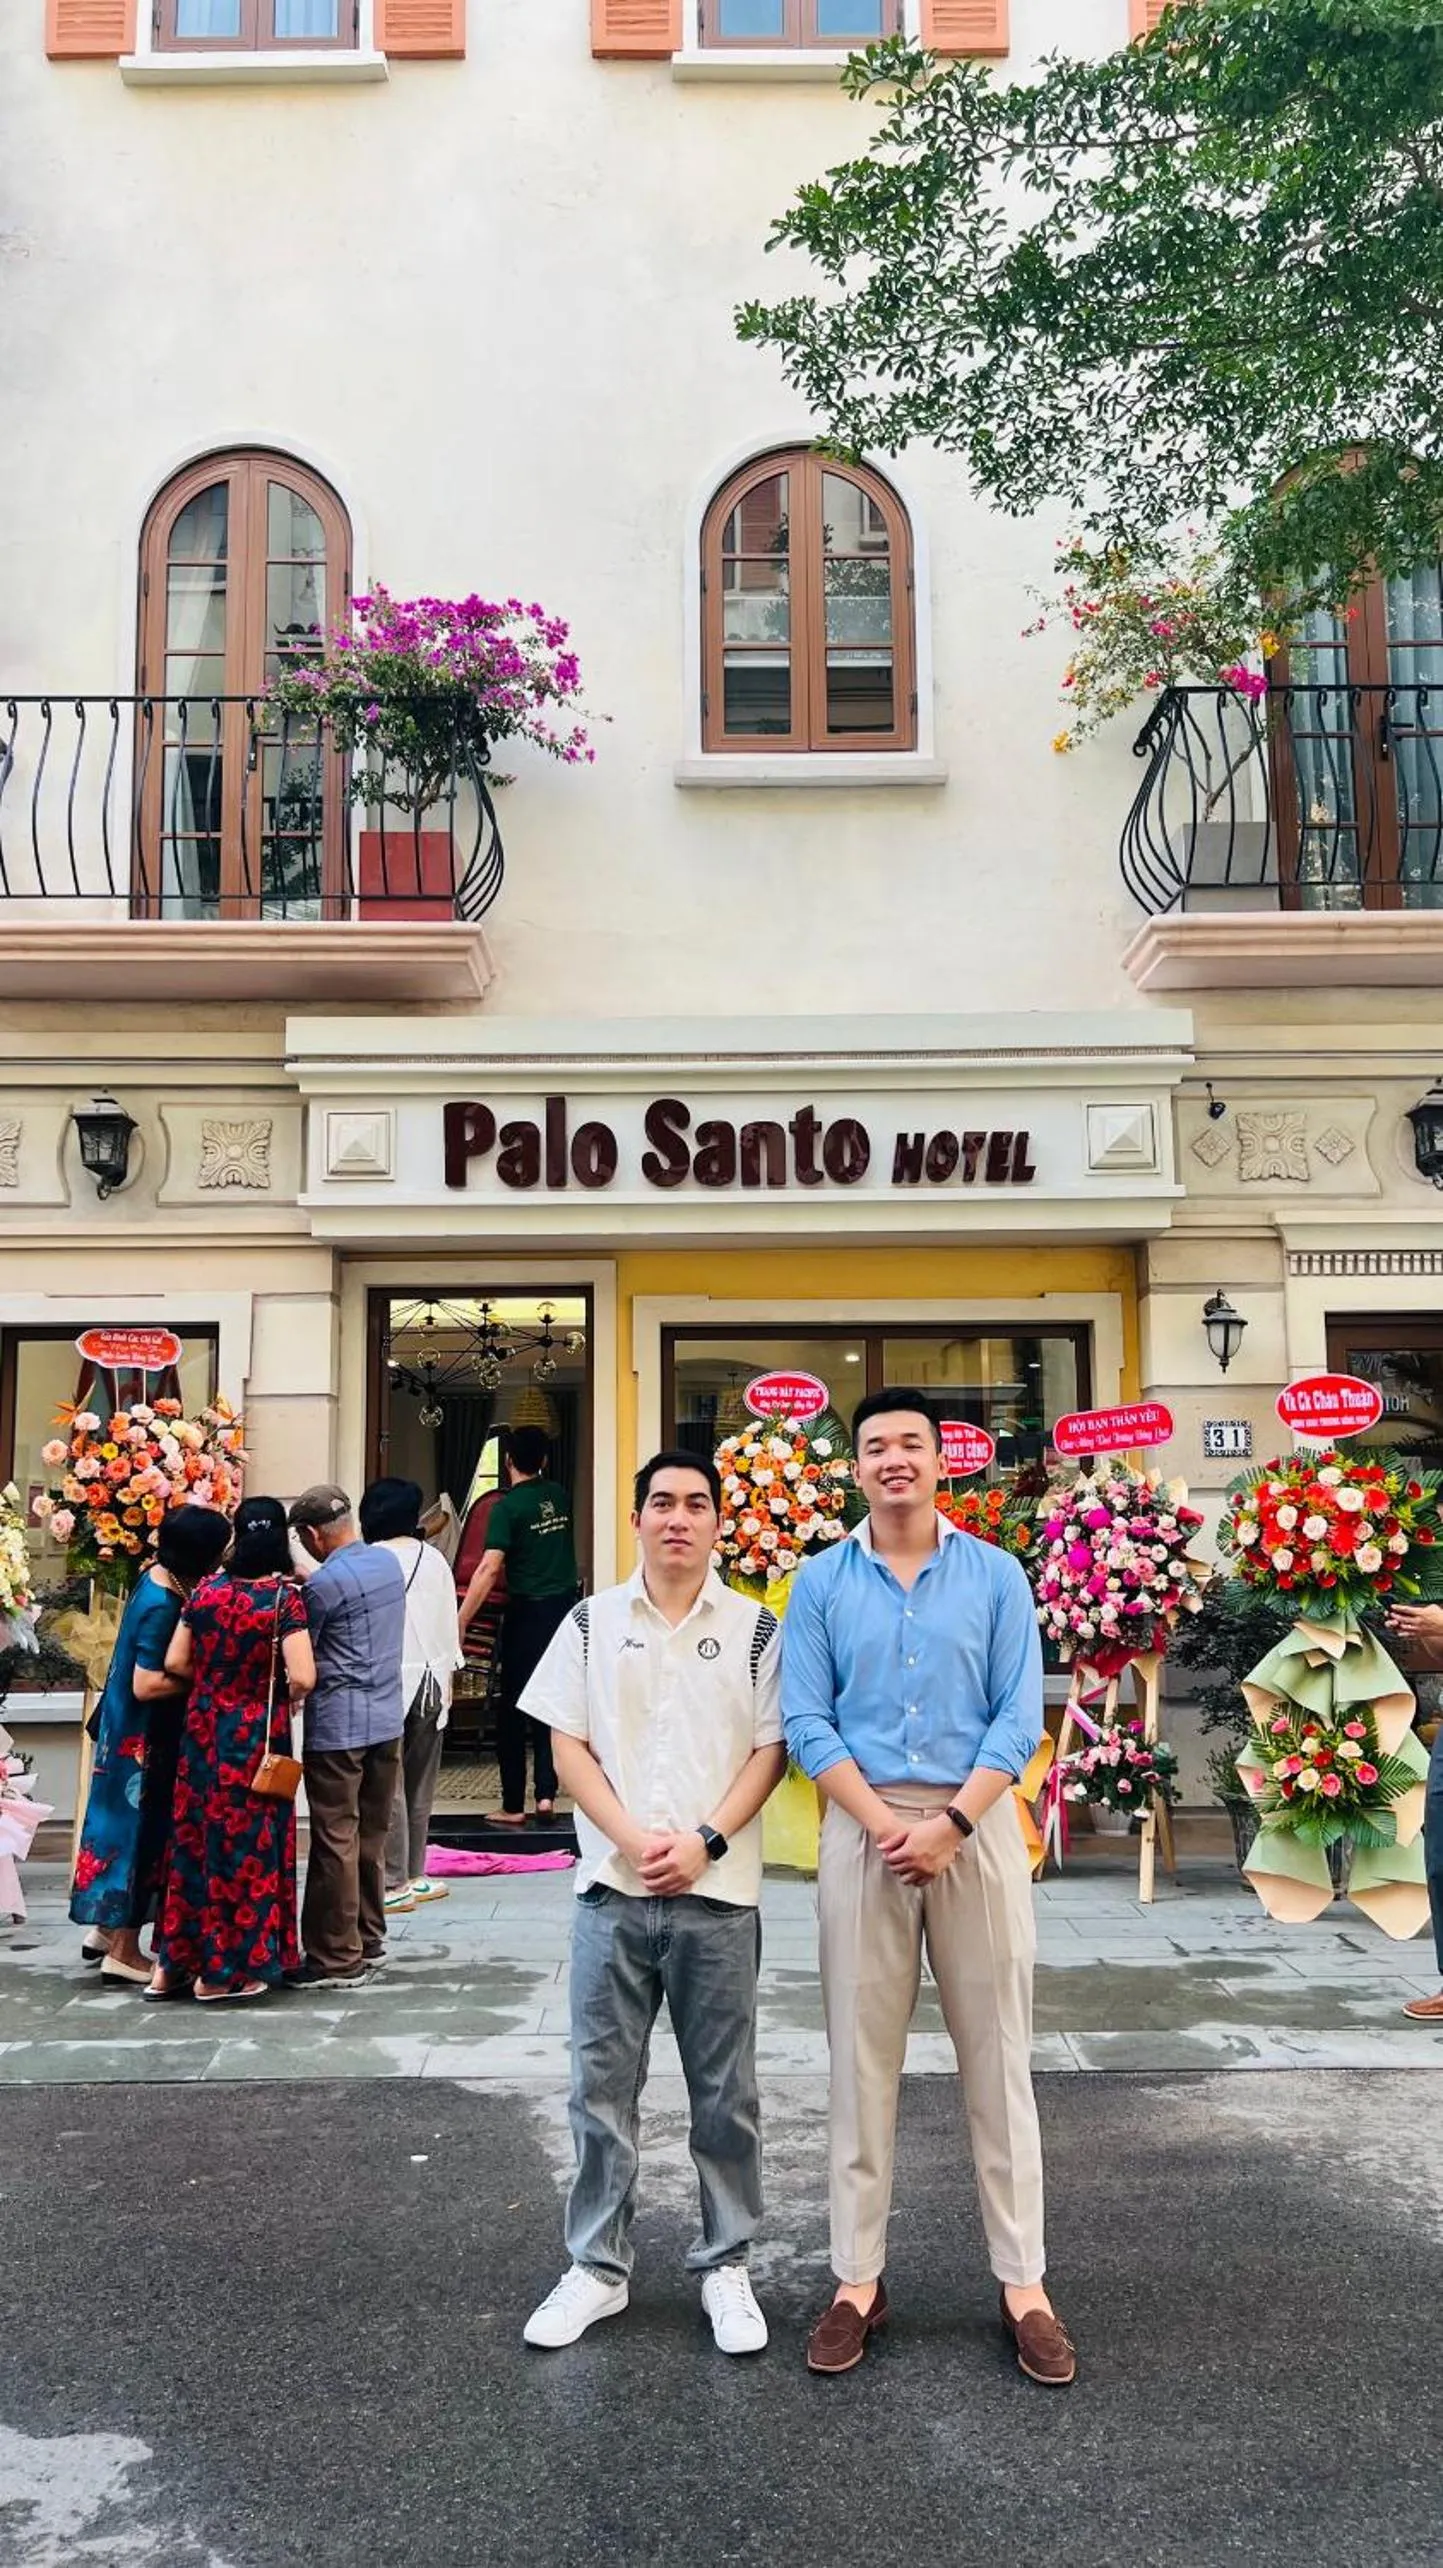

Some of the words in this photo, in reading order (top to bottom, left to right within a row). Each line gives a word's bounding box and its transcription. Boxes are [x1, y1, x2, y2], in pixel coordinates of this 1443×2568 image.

[443, 1095, 618, 1188] Palo
[642, 1098, 871, 1187] Santo
[891, 1130, 1037, 1184] HOTEL
[1213, 1429, 1239, 1448] 31
